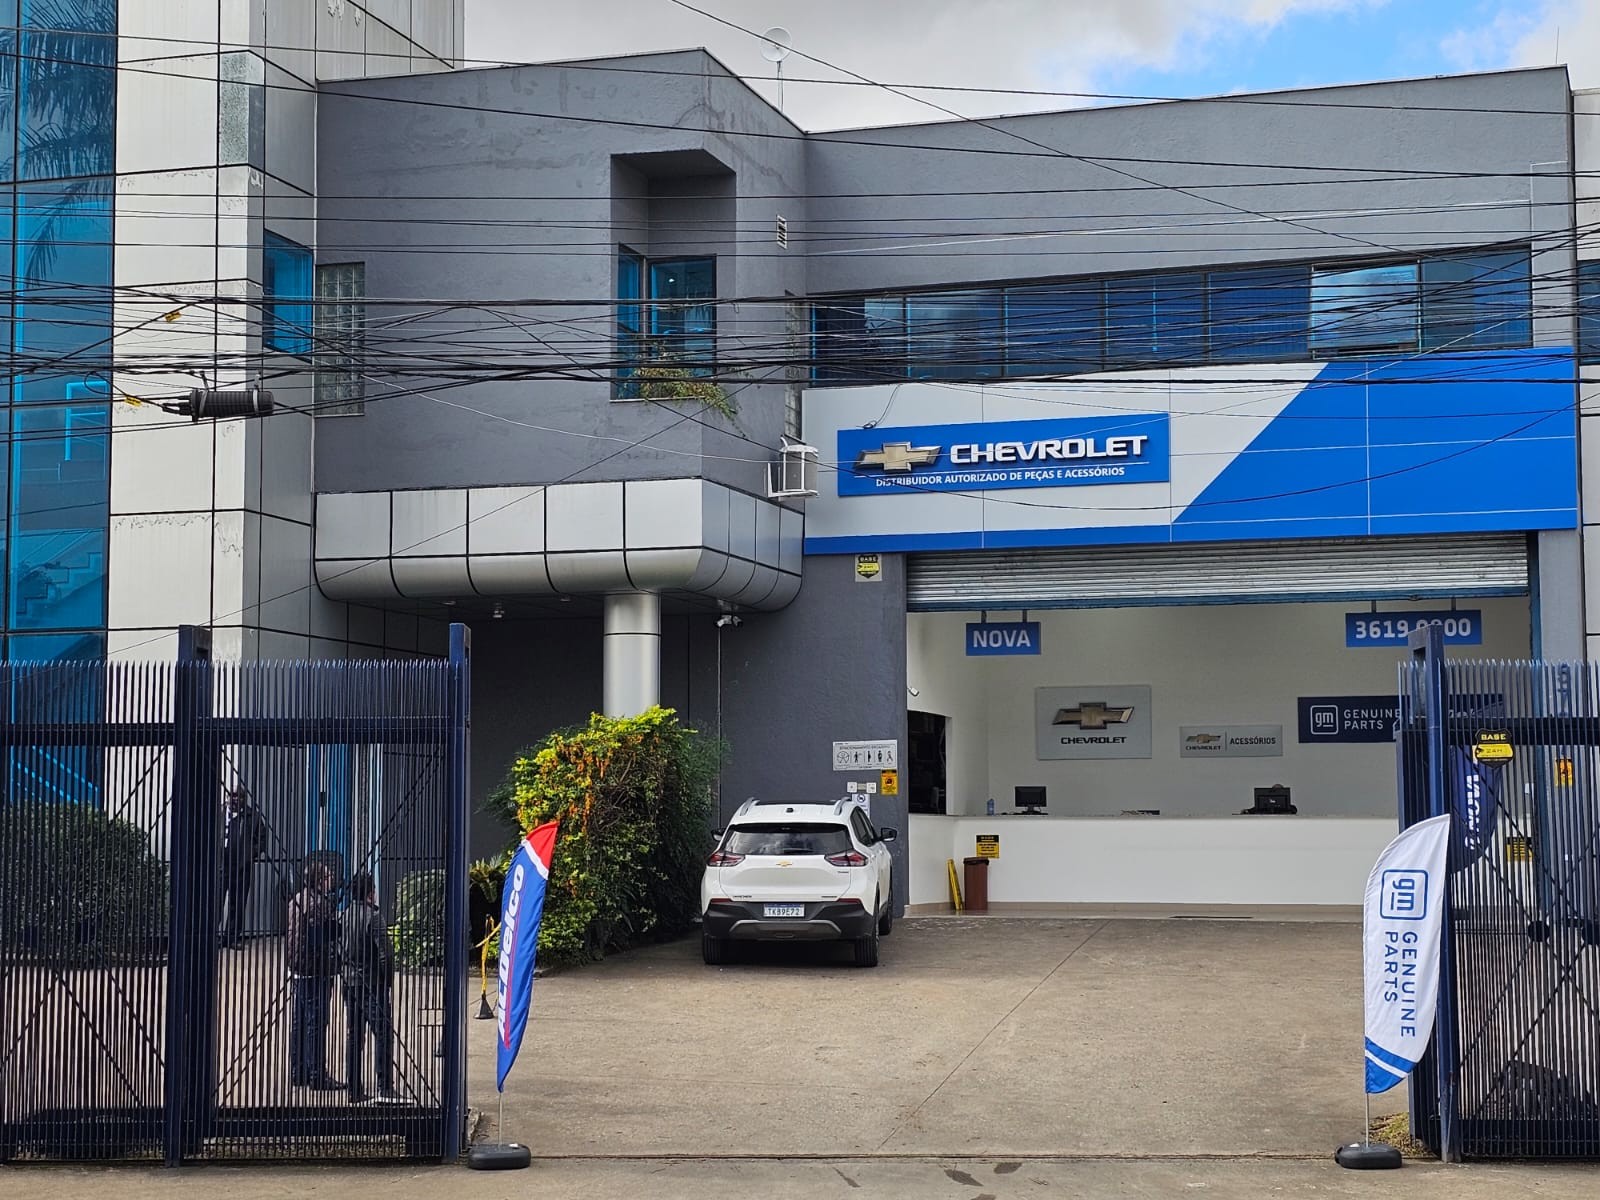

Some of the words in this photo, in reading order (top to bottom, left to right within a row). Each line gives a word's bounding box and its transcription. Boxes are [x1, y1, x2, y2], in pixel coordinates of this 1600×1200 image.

[950, 435, 1148, 464] CHEVROLET
[875, 476, 943, 487] DISTRIBUIDOR
[944, 472, 1007, 484] AUTORIZADO
[1009, 472, 1023, 481] DE
[1024, 470, 1055, 481] PEÇAS
[1056, 470, 1063, 479] E
[1064, 464, 1125, 479] ACESSÓRIOS
[973, 630, 1031, 648] NOVA
[1344, 720, 1384, 730] PARTS
[1060, 736, 1127, 745] CHEVROLET
[1229, 735, 1277, 745] ACESSÓRIOS
[1481, 733, 1507, 741] BASE
[1384, 931, 1398, 1003] PARTS
[1401, 931, 1418, 1038] GENUINE
